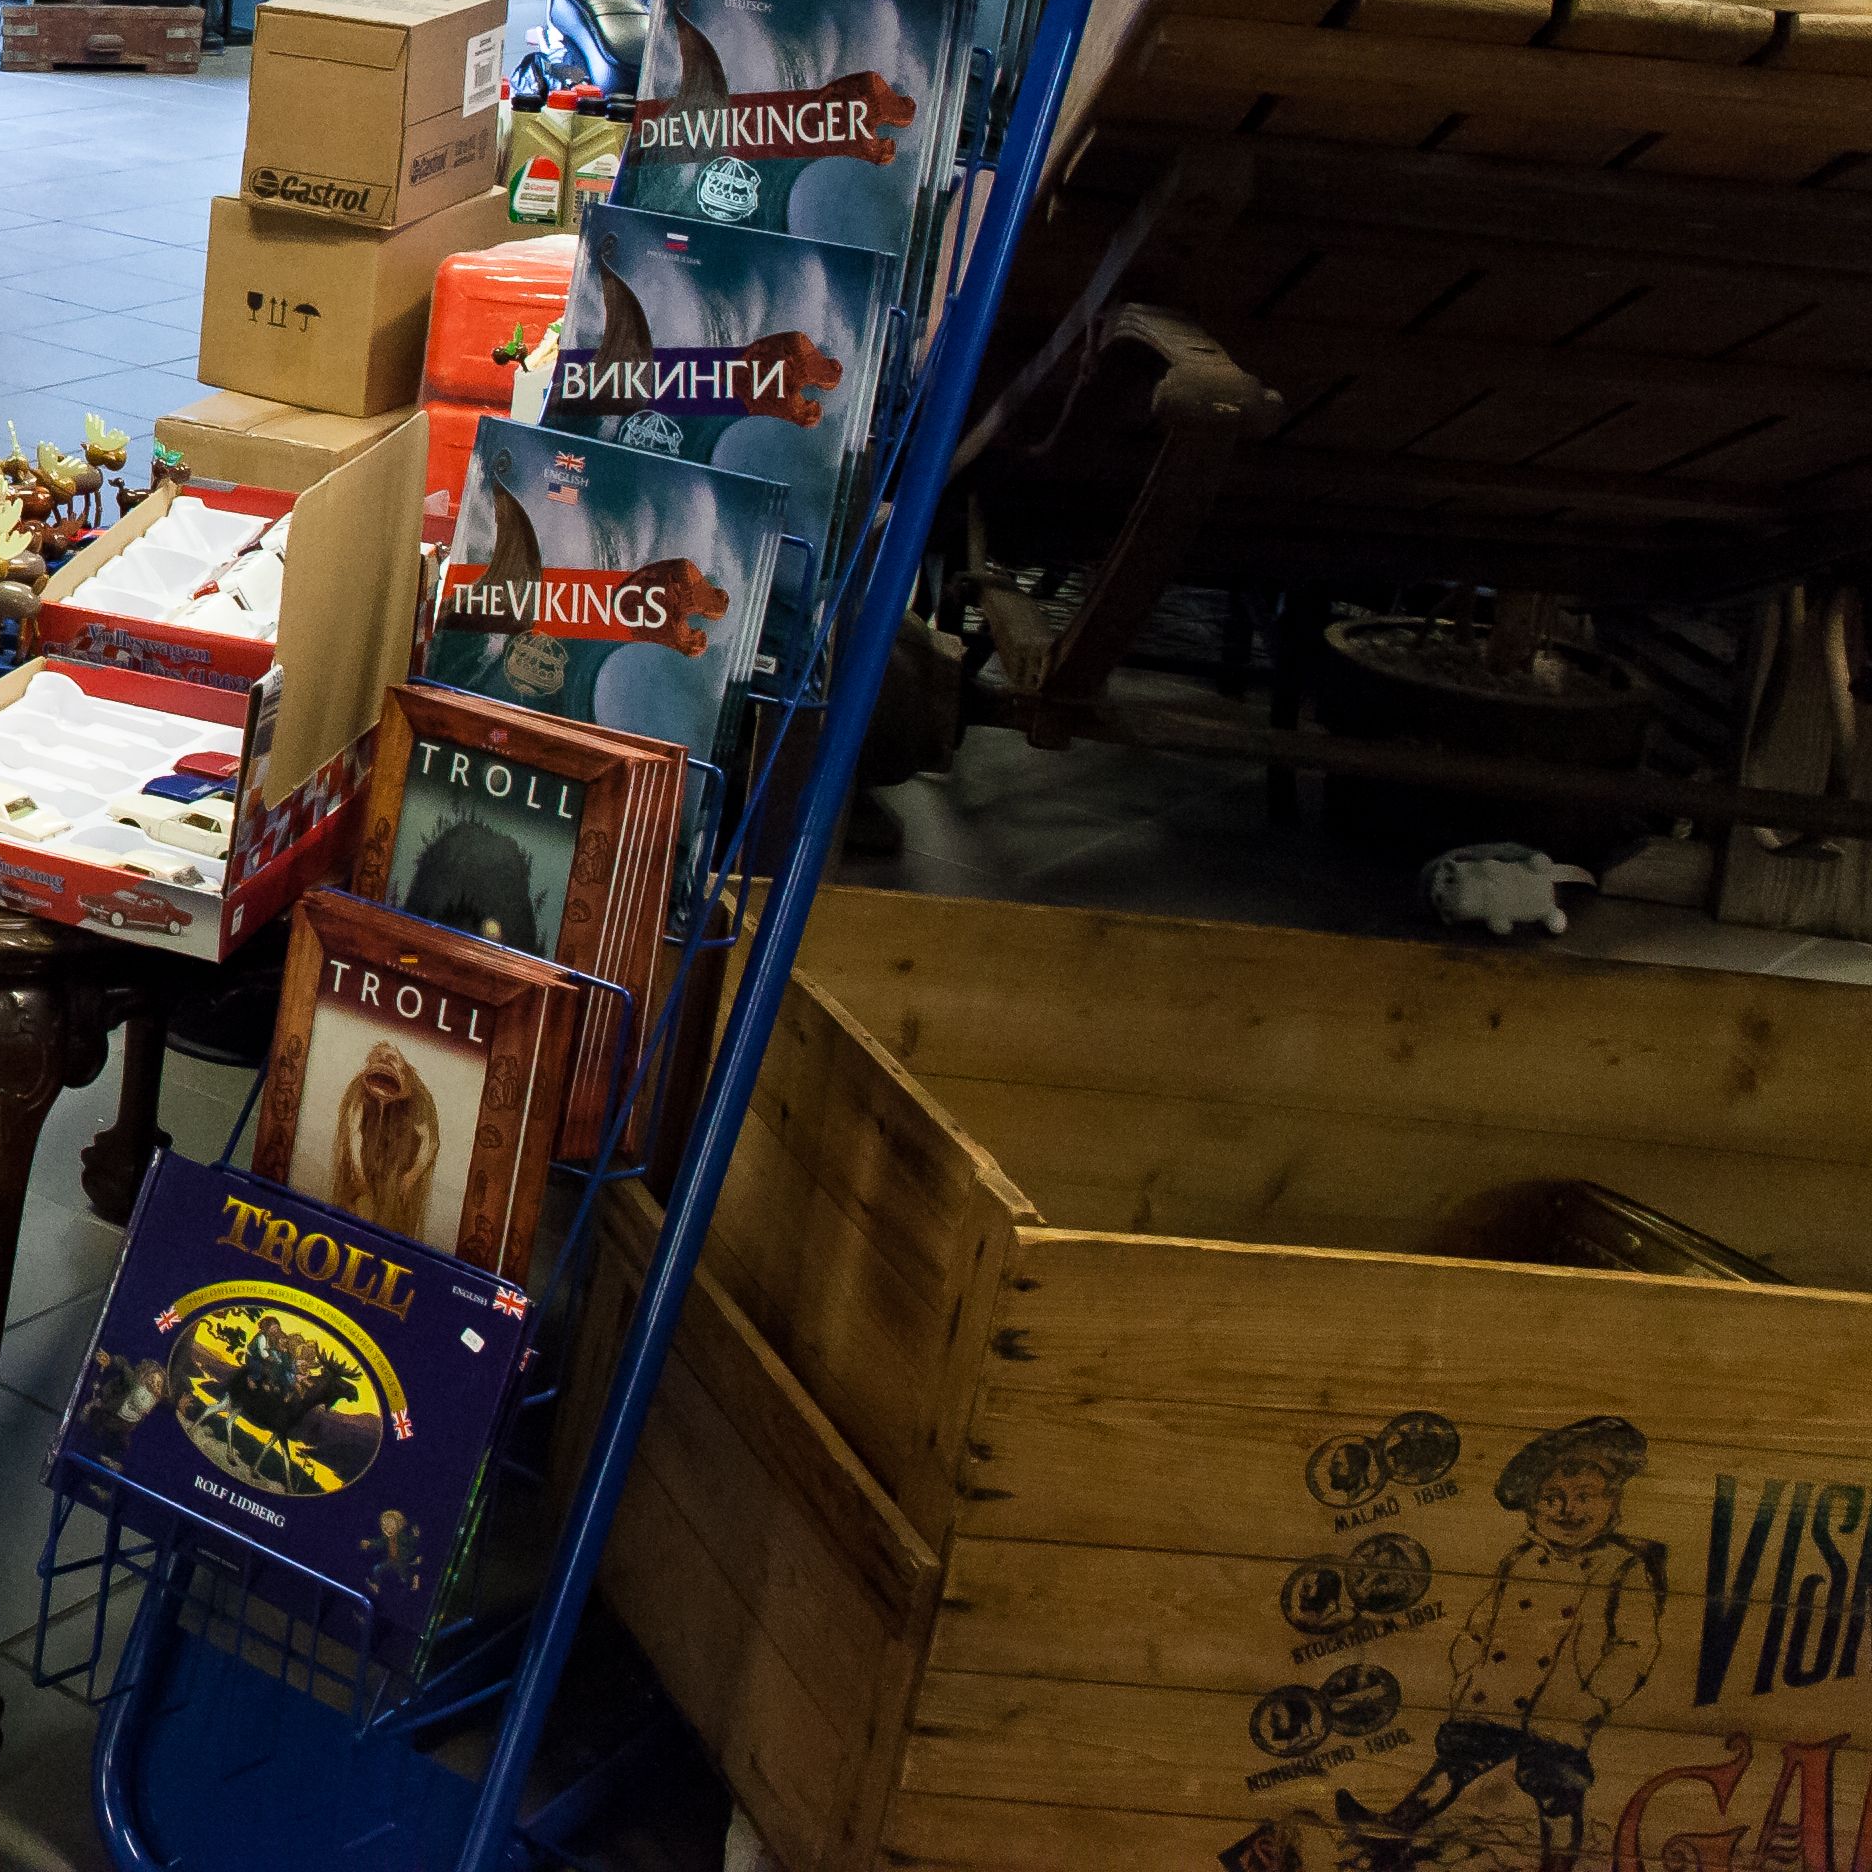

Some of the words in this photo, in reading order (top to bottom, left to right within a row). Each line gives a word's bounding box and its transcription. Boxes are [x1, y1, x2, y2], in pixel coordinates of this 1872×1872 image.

[280, 175, 372, 214] Castrol
[562, 358, 787, 400] ВИКИНГИ
[418, 741, 573, 820] TROLL
[329, 958, 485, 1044] TROLL
[216, 1193, 417, 1322] TROLL
[194, 1474, 229, 1500] ROLF
[228, 1491, 286, 1528] LIDBERG
